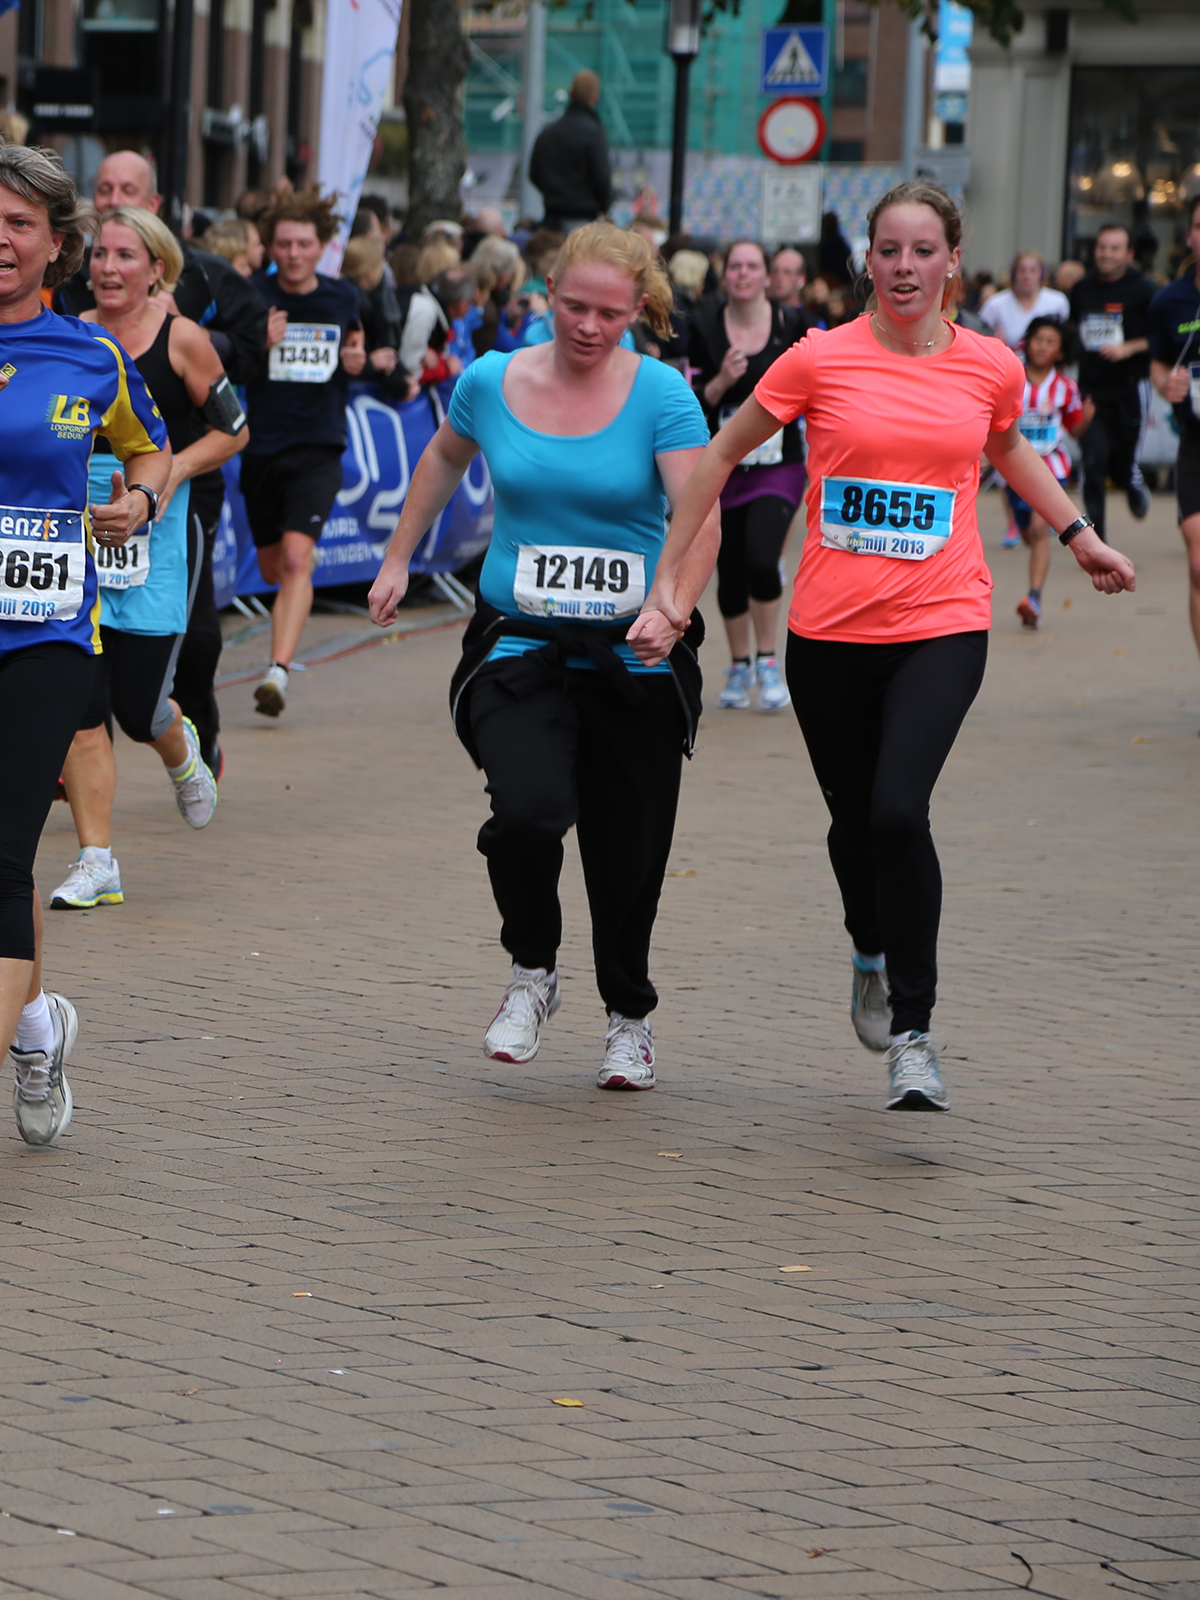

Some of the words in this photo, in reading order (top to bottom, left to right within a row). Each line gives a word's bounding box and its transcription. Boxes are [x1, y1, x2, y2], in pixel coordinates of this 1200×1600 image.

[280, 346, 330, 366] 13434
[841, 485, 936, 531] 8655
[890, 537, 925, 555] 2013
[533, 554, 630, 594] 12149
[21, 599, 56, 618] 2013
[585, 601, 617, 616] 2013
